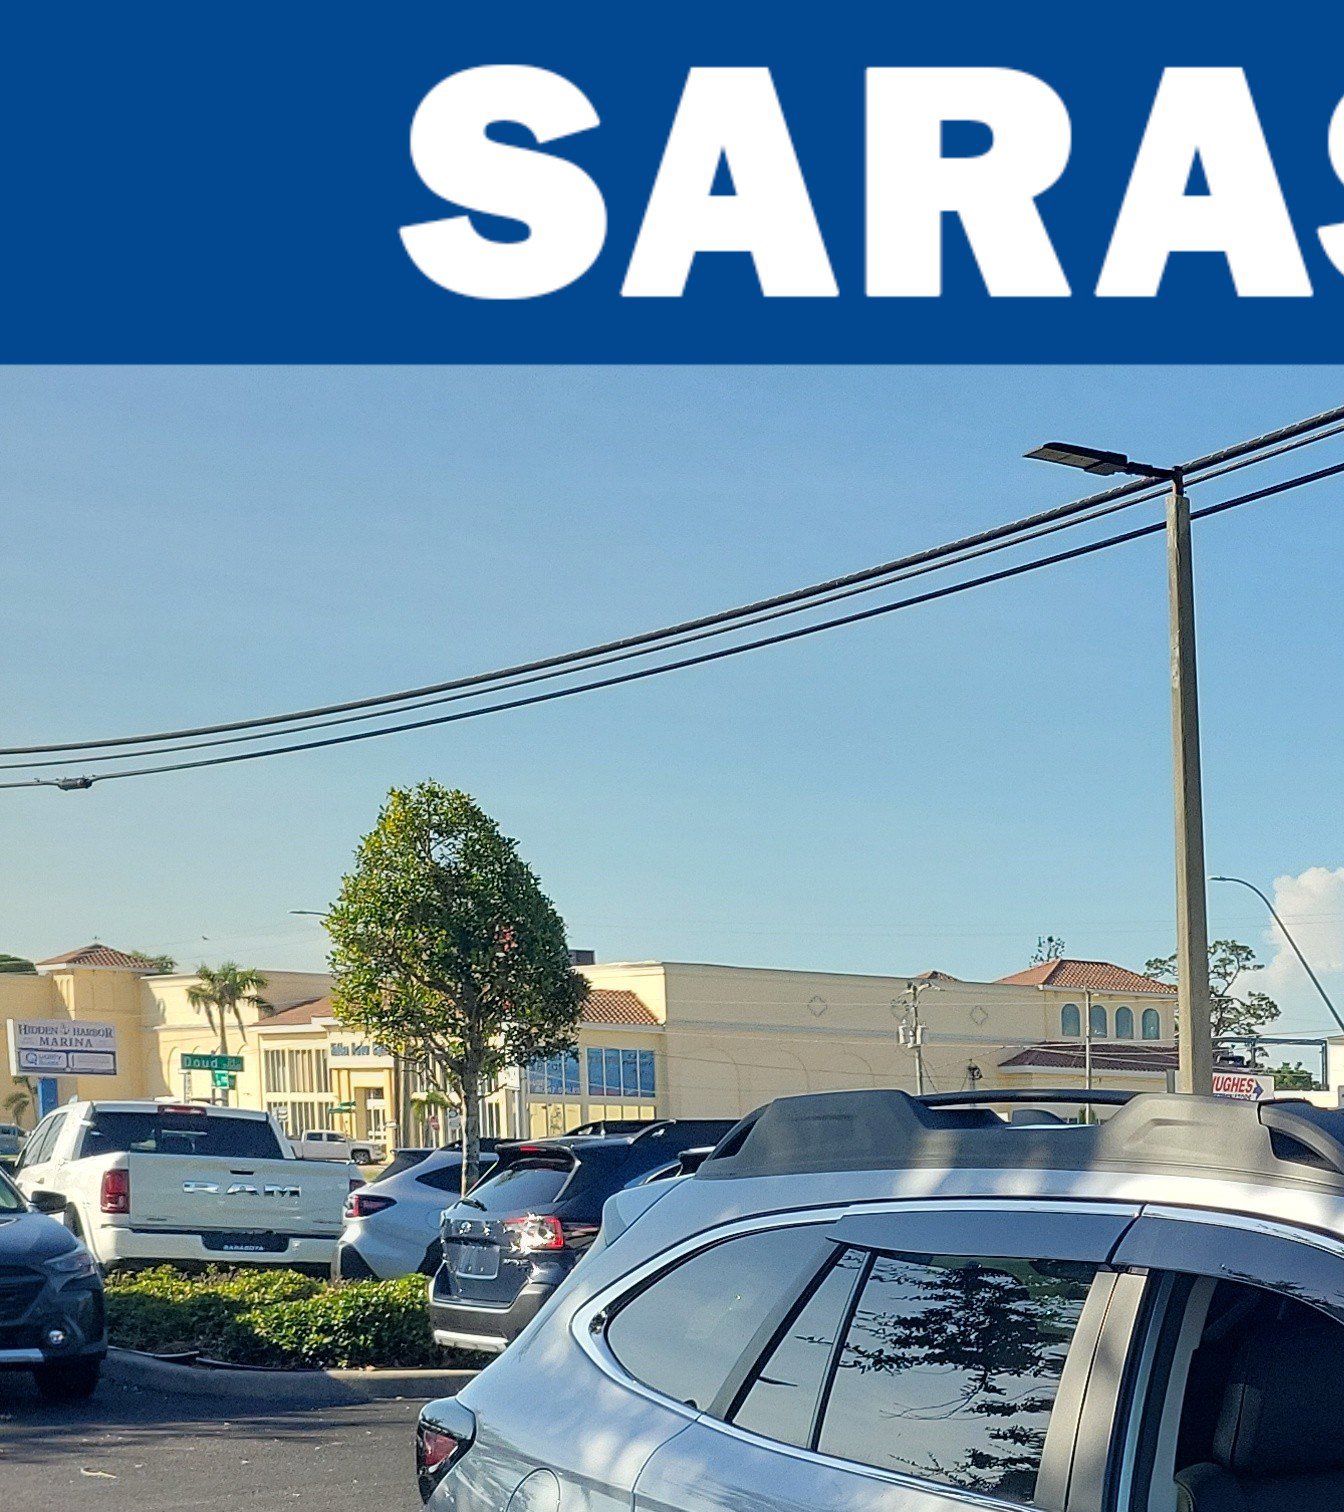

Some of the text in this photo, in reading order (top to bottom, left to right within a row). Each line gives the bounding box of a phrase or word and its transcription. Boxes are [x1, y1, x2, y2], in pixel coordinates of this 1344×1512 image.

[18, 1024, 113, 1038] HIDDEN HARBOR
[40, 1036, 93, 1048] MARINA
[183, 1055, 218, 1068] Doud
[183, 1180, 301, 1197] RAM
